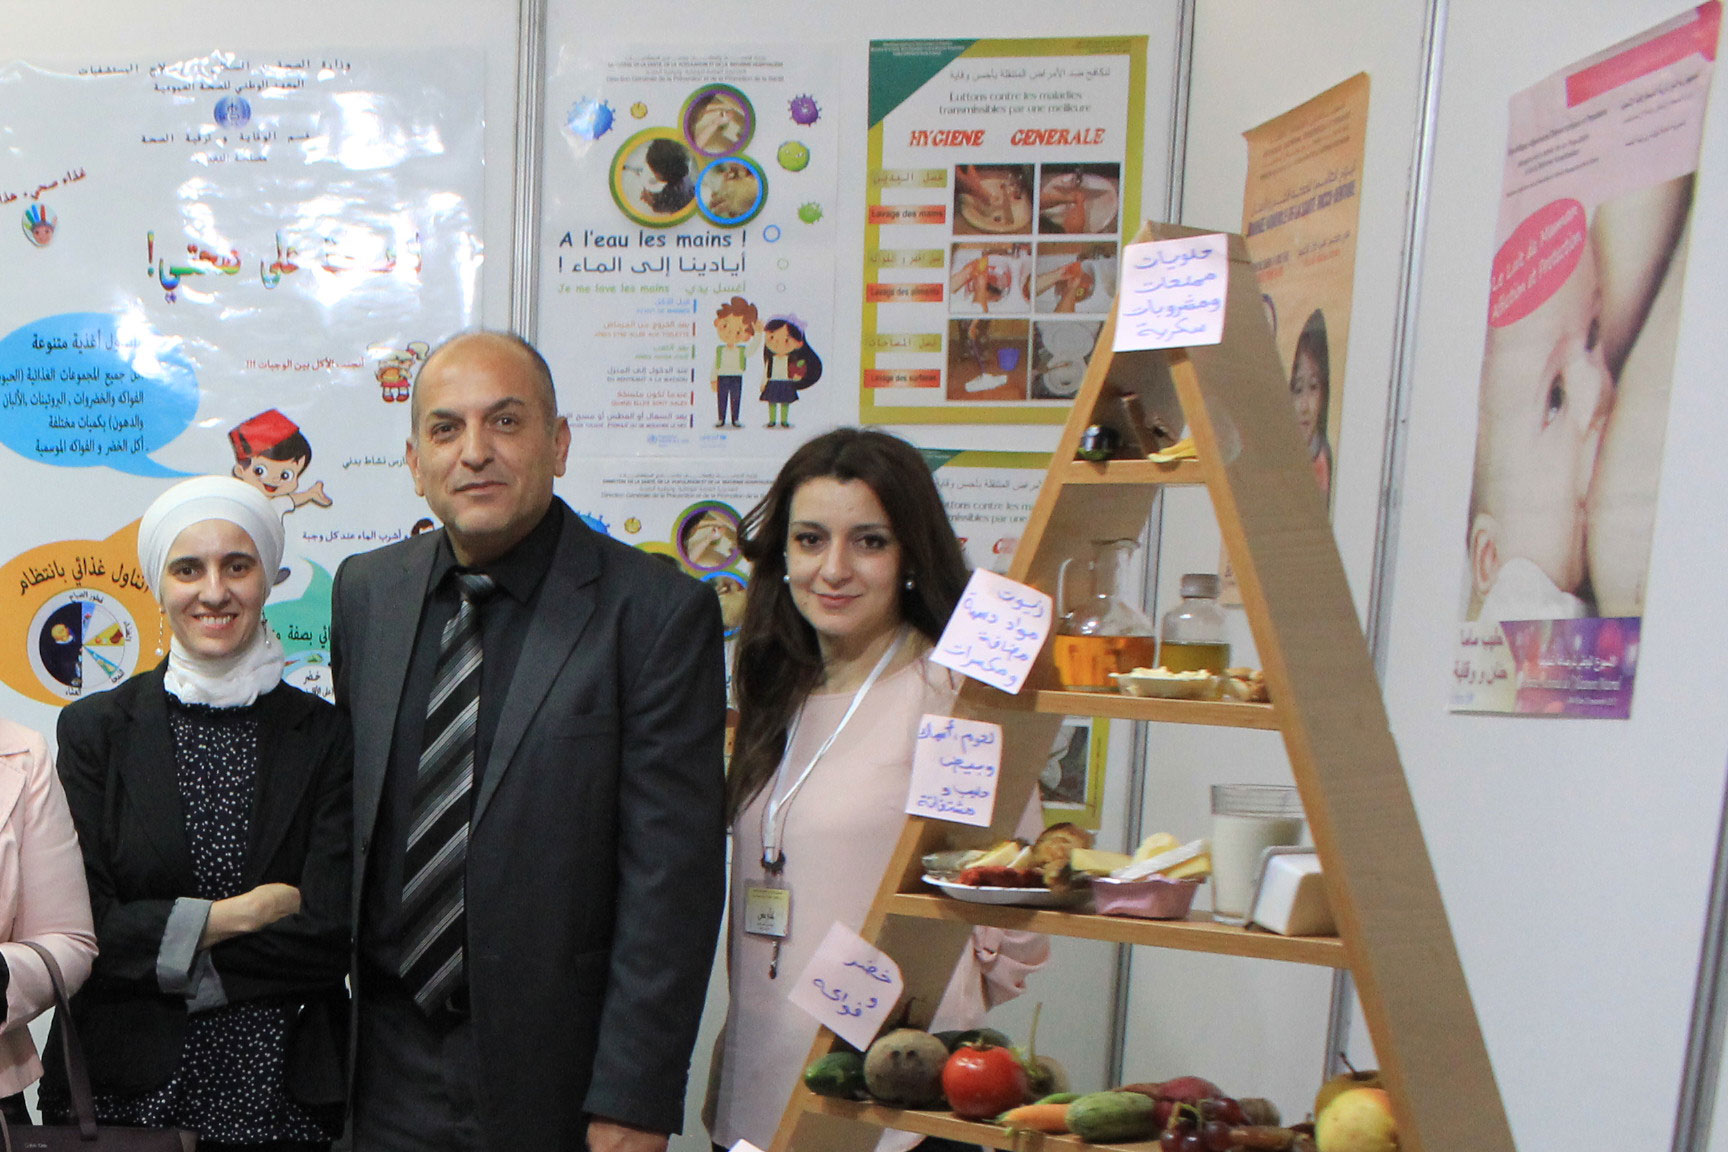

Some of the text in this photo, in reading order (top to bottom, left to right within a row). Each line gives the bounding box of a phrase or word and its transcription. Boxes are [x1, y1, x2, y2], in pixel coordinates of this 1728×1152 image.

[949, 90, 1083, 102] Luttons contre les maladies
[939, 103, 1091, 116] transmissibles par une meilleure
[141, 133, 174, 144] الصحة
[908, 127, 1106, 148] HYGIENE GENERALE
[901, 209, 917, 218] des
[559, 229, 732, 248] A l'eau les mains
[572, 250, 746, 277] أيادينا إلى الماء
[1135, 247, 1213, 271] حلويات
[558, 283, 670, 294] Je me lave les mains
[684, 285, 708, 296] يدي
[1136, 317, 1207, 342] سكرية
[32, 333, 68, 354] متنوعة
[72, 329, 101, 354] أغذية
[258, 358, 310, 372] بين الوجبات
[27, 367, 55, 385] الغذائية
[60, 366, 100, 384] المجموعات
[104, 373, 125, 387] جميع
[48, 414, 106, 432] بكميات مختلفة
[36, 438, 128, 457] الخضر الفواكه الموسمية
[302, 528, 402, 543] أشرب الماء عند كل وجبة
[20, 555, 106, 596] غذائي بانتظام
[287, 624, 313, 646] بصفة
[303, 670, 321, 685] خضر
[842, 959, 892, 984] خضر
